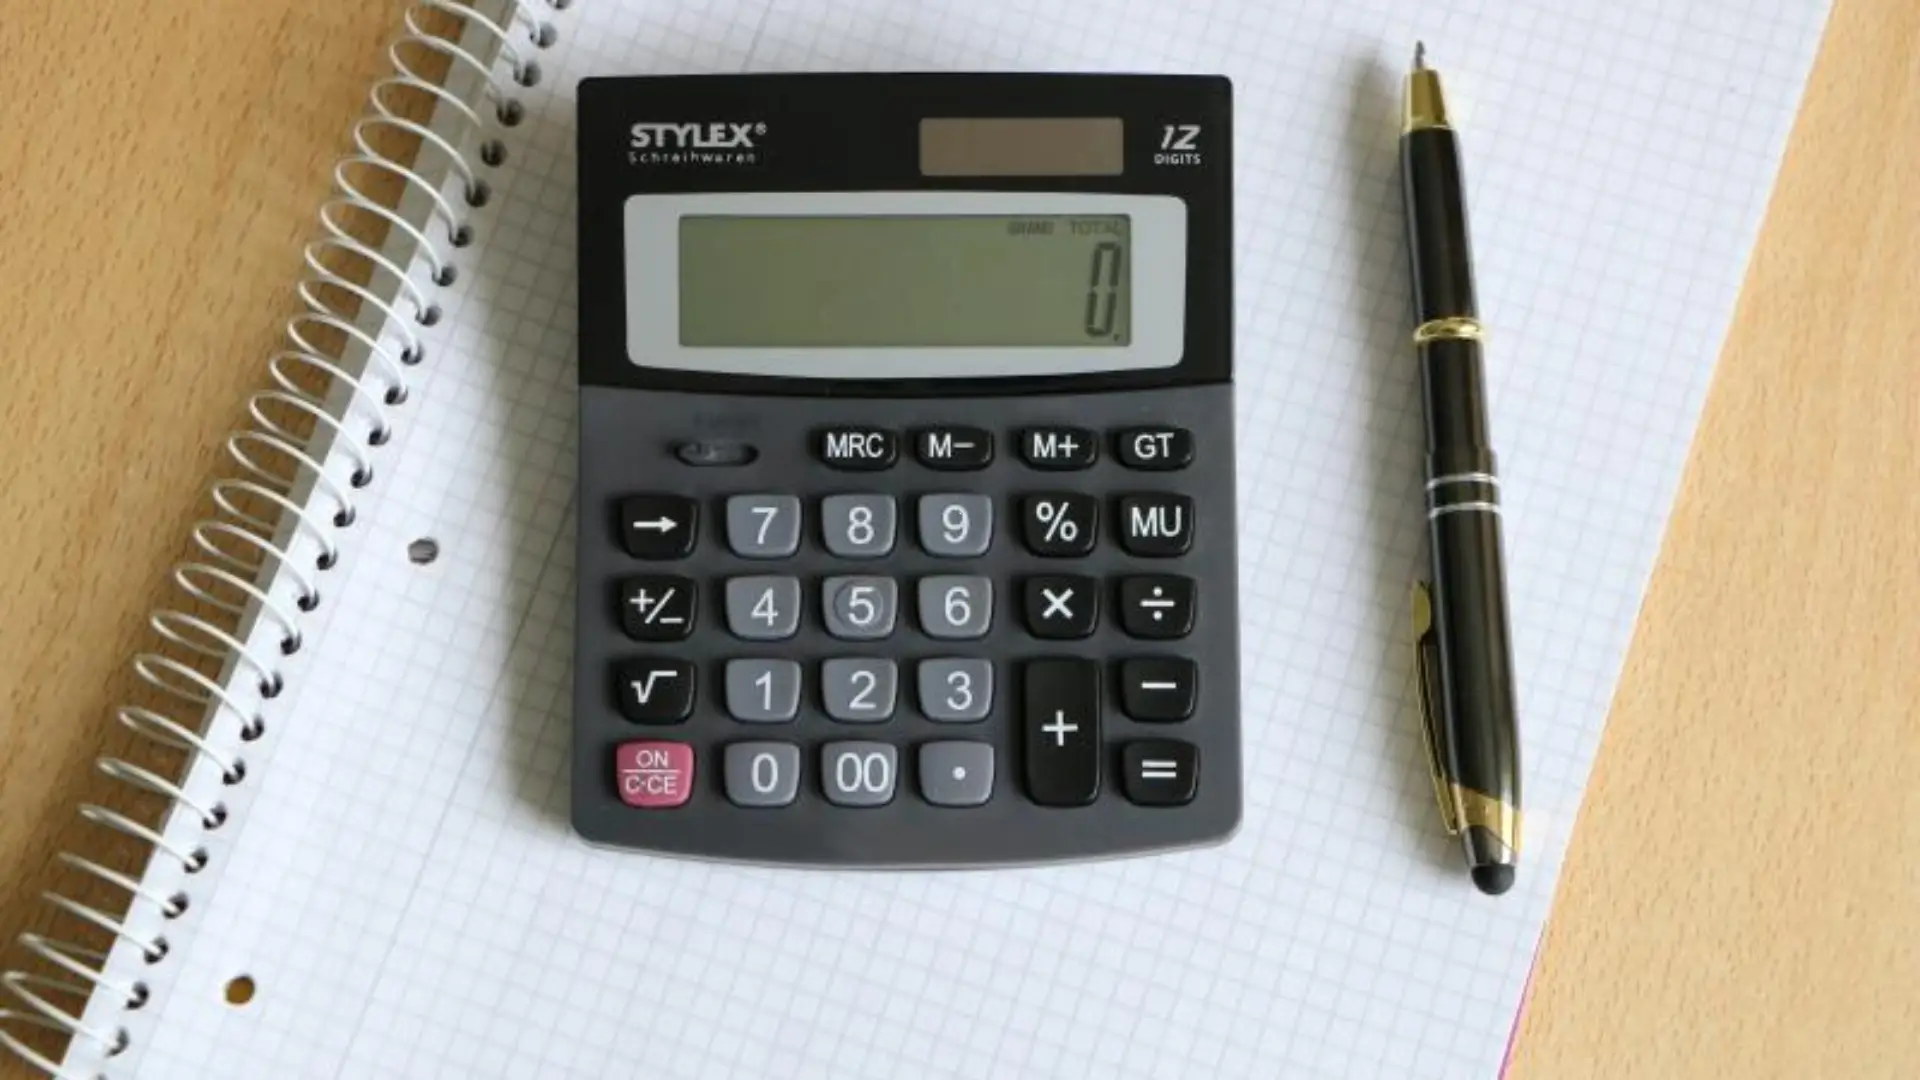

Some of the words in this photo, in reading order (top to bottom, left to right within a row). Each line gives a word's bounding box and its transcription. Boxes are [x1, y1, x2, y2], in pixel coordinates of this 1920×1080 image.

[1160, 124, 1202, 151] 12
[1154, 153, 1202, 165] DIGITS
[1070, 220, 1121, 236] TOTAL
[827, 432, 884, 459] MRC
[1033, 433, 1080, 459] M+
[1134, 432, 1175, 459] GT
[751, 507, 778, 545] 7
[847, 506, 874, 545] 8
[942, 507, 970, 545] 9
[1035, 501, 1079, 542] %
[1131, 506, 1183, 539] MU
[751, 588, 779, 626] 4
[848, 587, 875, 626] 5
[944, 587, 971, 626] 6
[755, 671, 772, 710] 1
[849, 671, 876, 710] 2
[947, 671, 973, 711] 3
[636, 750, 669, 769] ON
[752, 752, 779, 793] 0
[835, 752, 891, 793] 00
